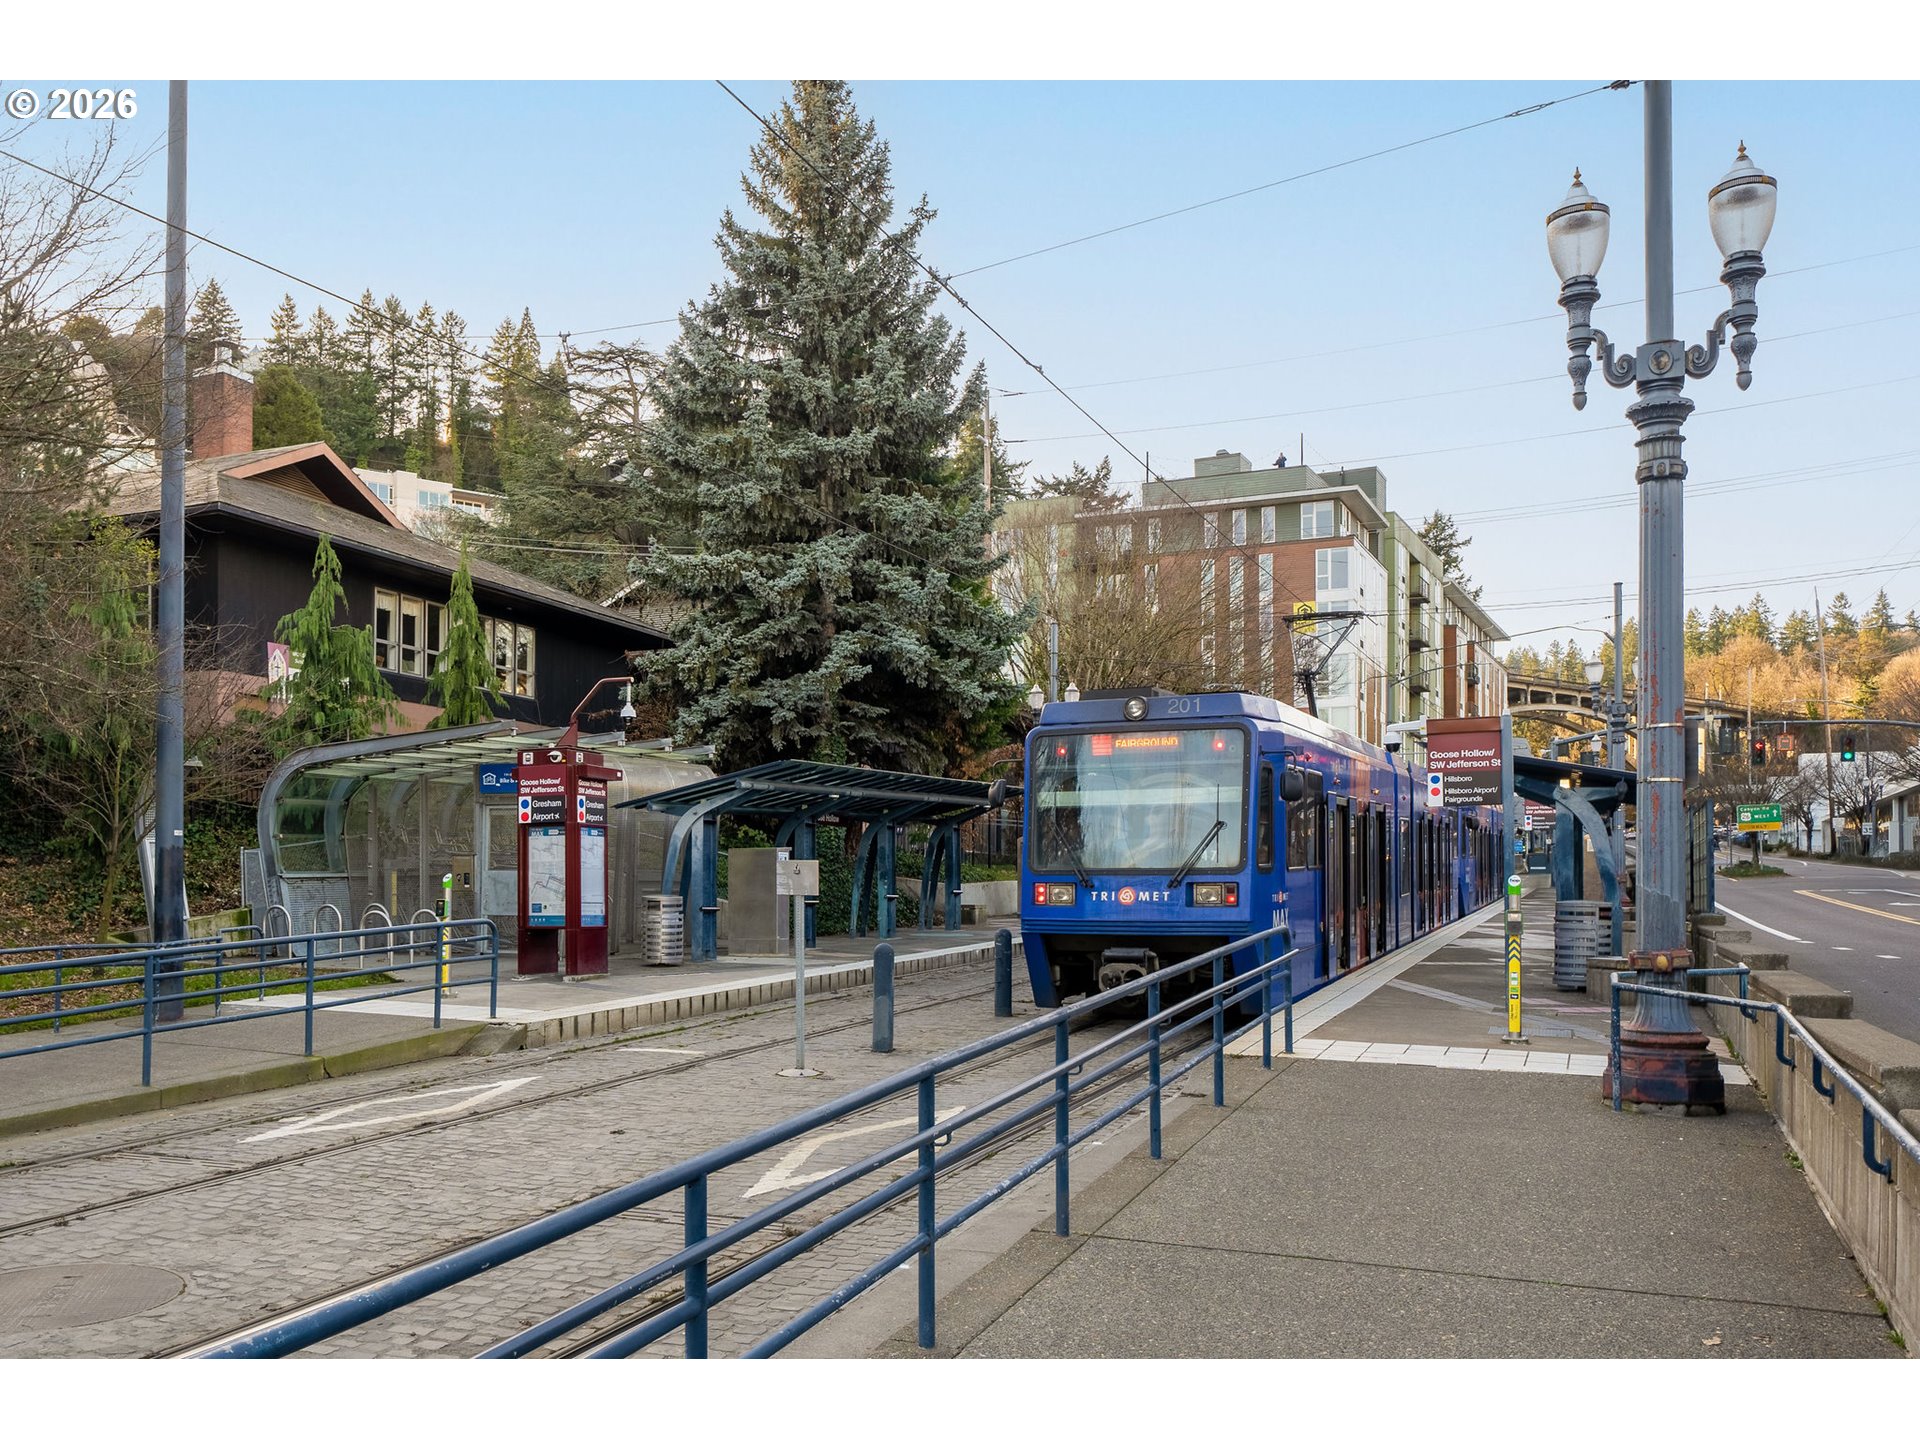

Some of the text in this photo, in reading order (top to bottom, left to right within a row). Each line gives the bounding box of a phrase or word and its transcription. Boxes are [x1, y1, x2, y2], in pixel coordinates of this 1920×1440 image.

[1167, 697, 1201, 714] 201
[1430, 748, 1495, 759] Goose Hollow/
[1430, 758, 1502, 769] SW Jefferson St
[530, 786, 557, 794] Jefferson
[1473, 786, 1498, 794] Airport/
[532, 800, 562, 808] Gresham
[1444, 796, 1483, 804] Fairgrounds
[586, 801, 604, 809] Gresham
[532, 813, 555, 821] Airport
[586, 813, 600, 821] Airport
[1272, 907, 1290, 928] MAX
